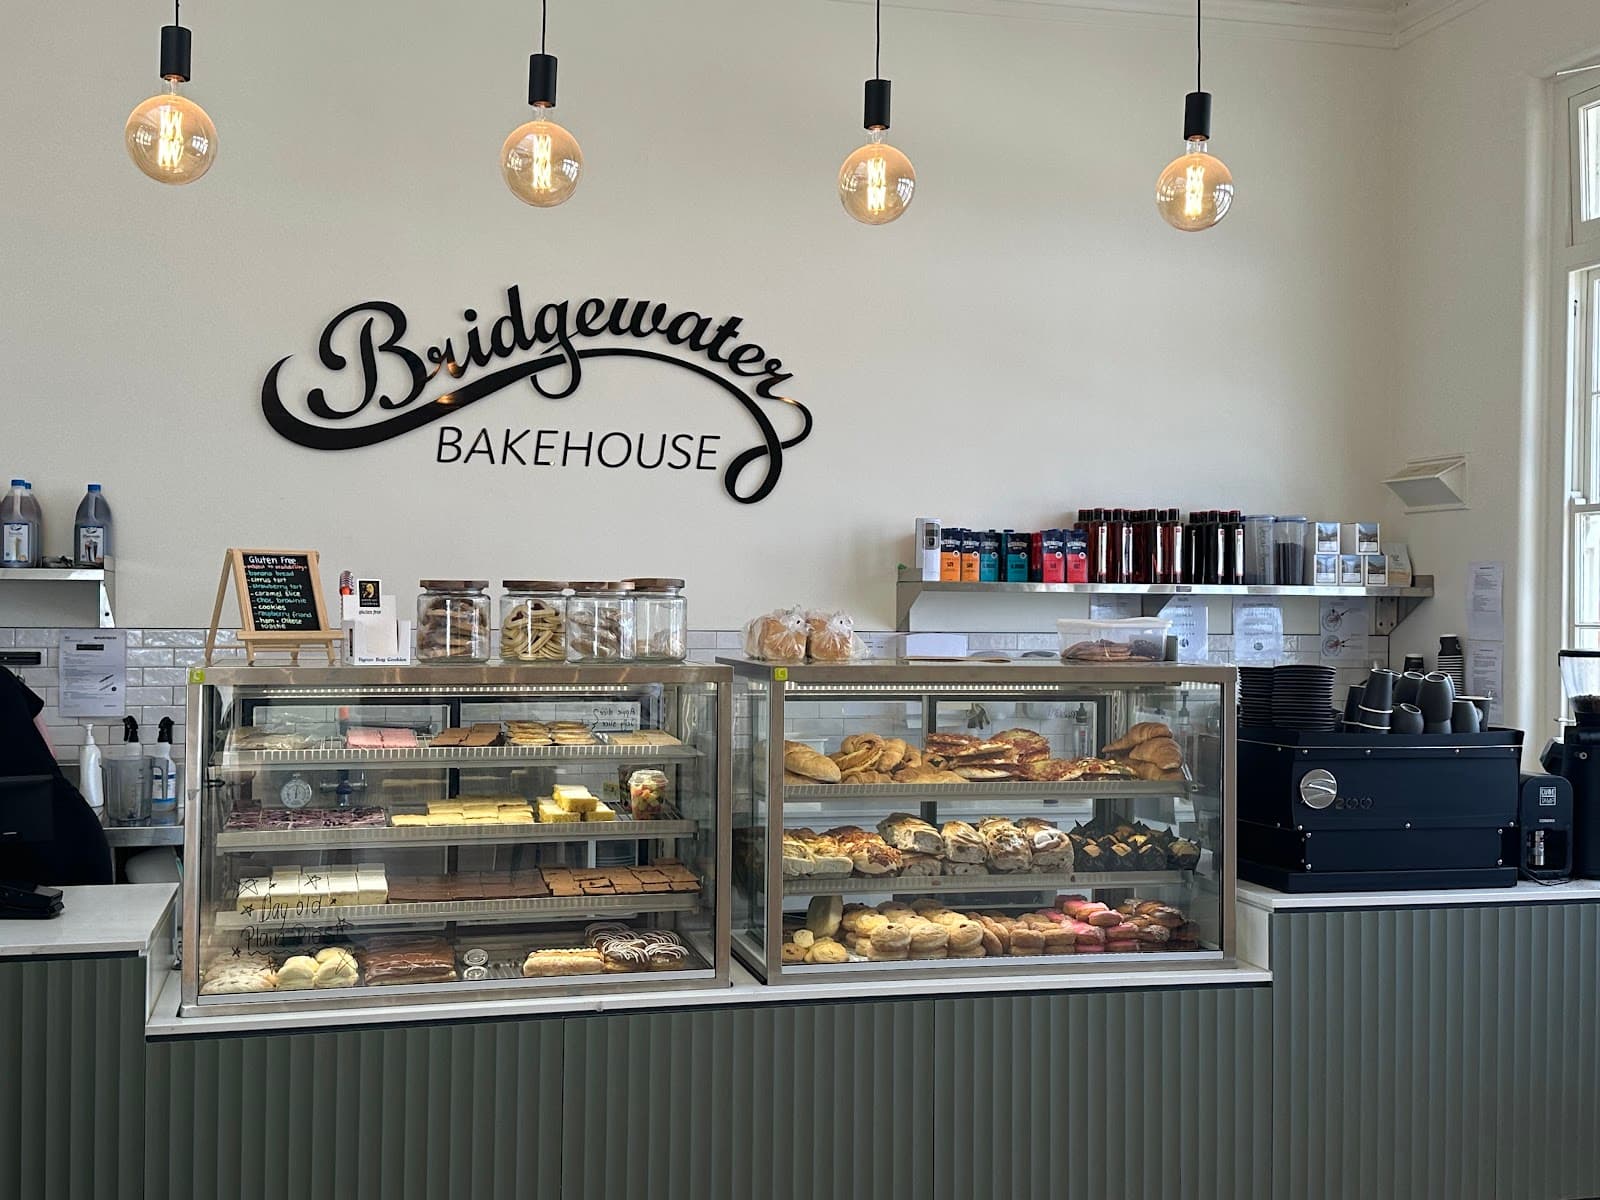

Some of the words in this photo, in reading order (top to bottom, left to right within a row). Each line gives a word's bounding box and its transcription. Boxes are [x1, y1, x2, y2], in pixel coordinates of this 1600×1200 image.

[303, 284, 799, 423] Bridgewater
[436, 426, 721, 471] BAKEHOUSE
[248, 555, 278, 565] Gluten
[280, 556, 297, 564] Free
[259, 893, 289, 935] Day
[296, 896, 322, 916] old
